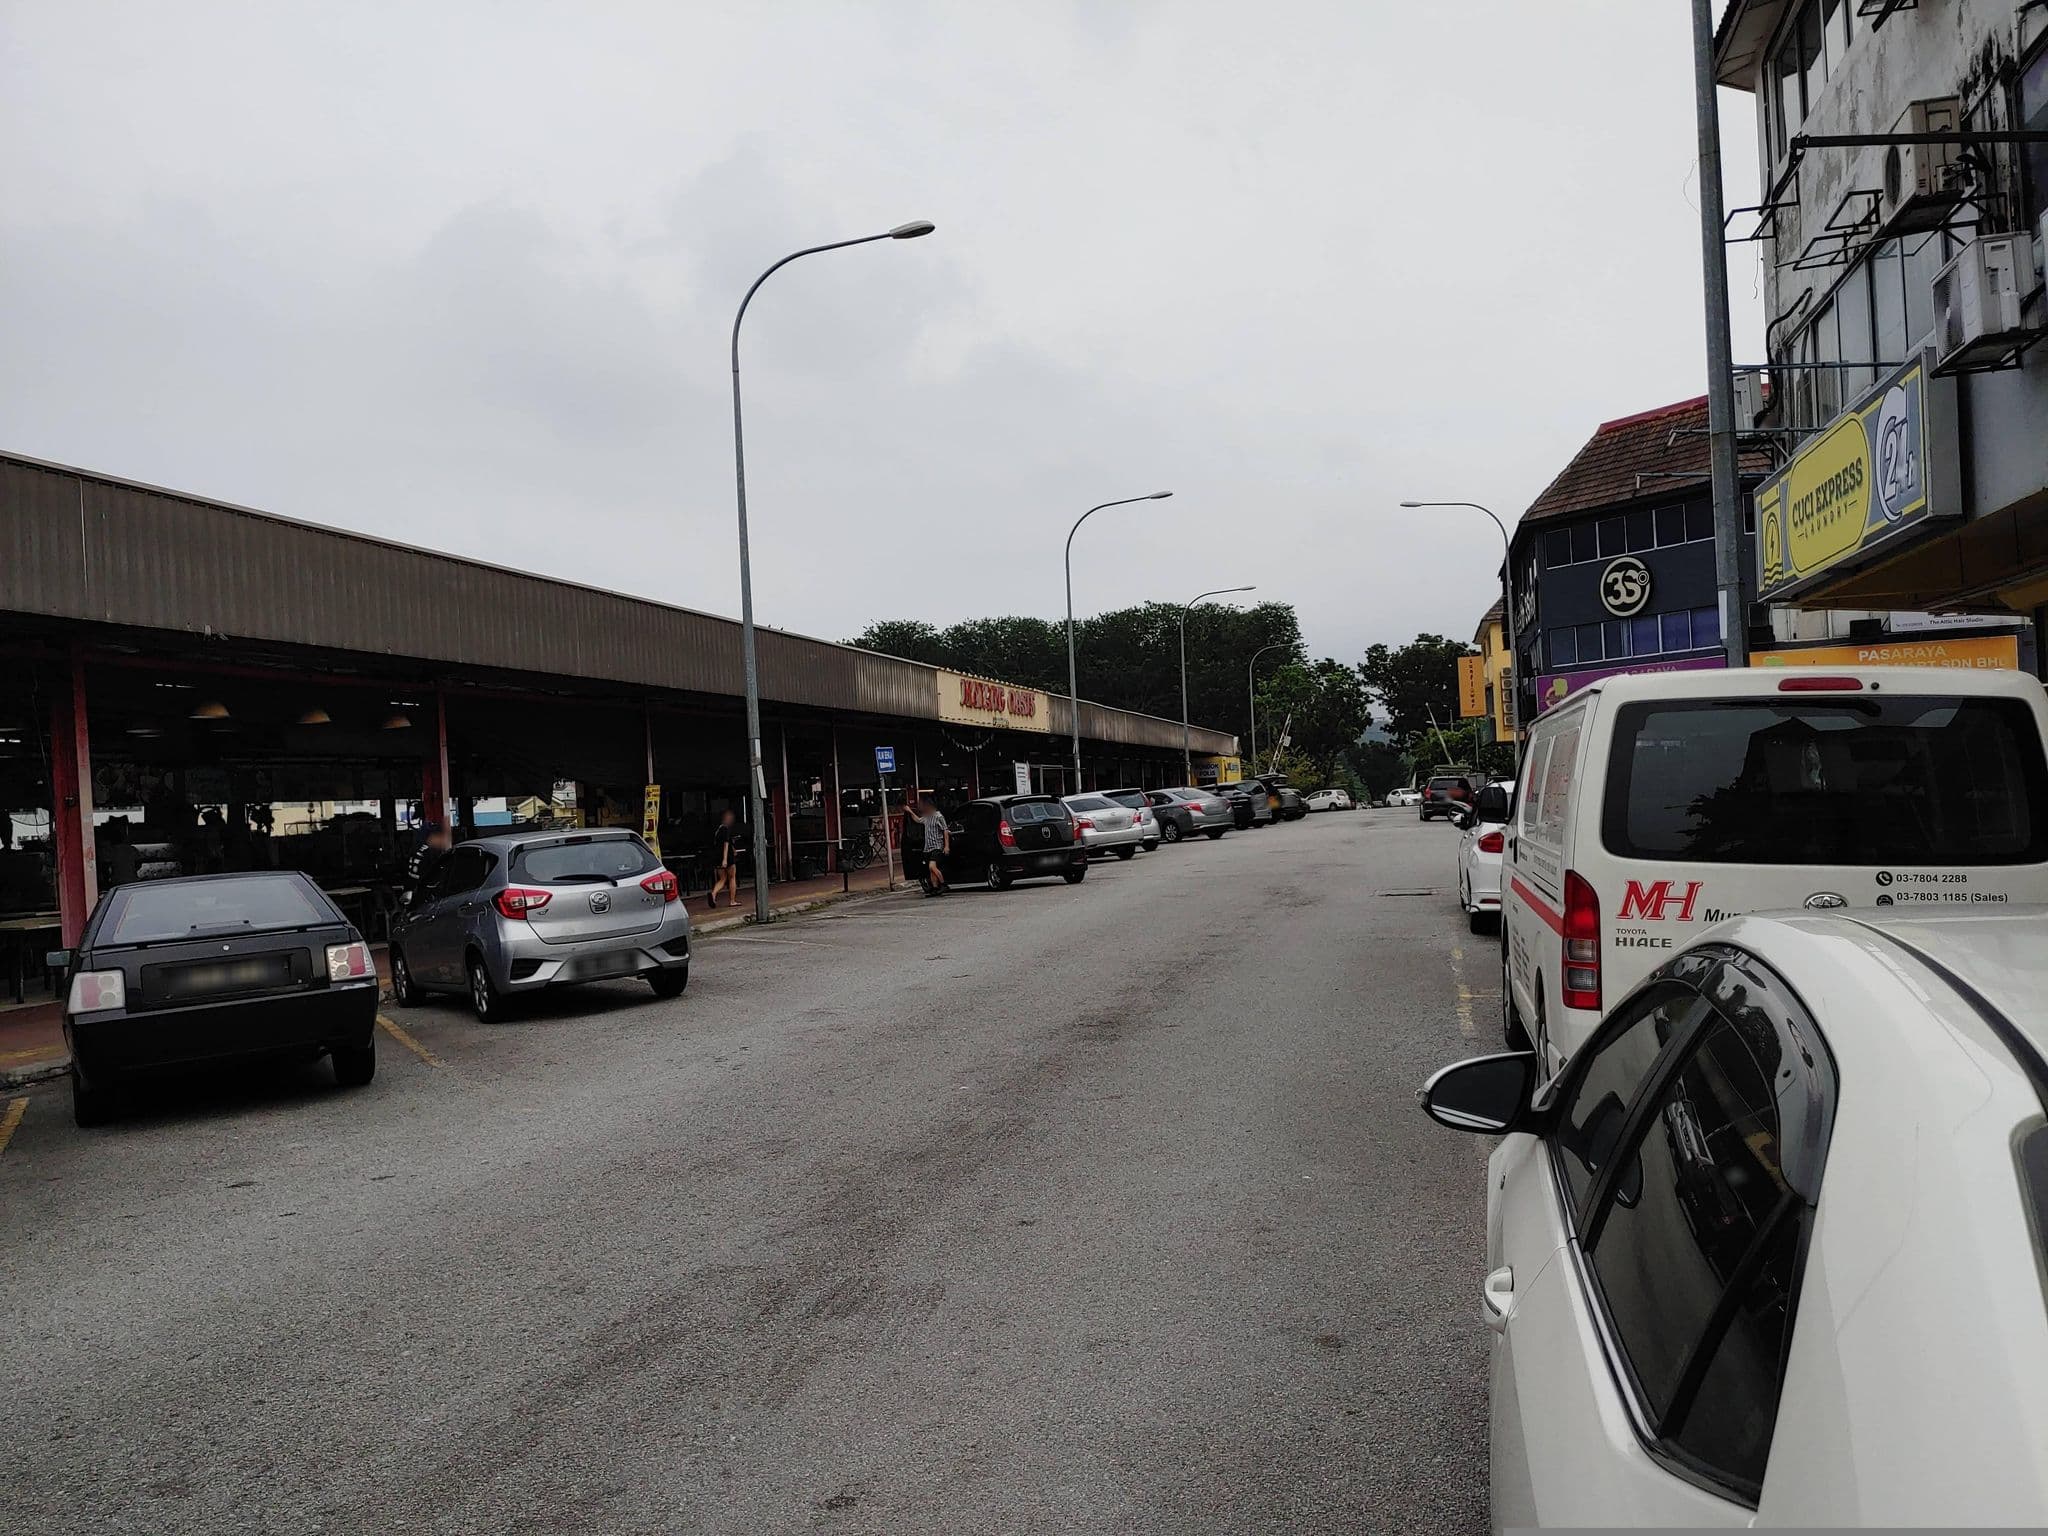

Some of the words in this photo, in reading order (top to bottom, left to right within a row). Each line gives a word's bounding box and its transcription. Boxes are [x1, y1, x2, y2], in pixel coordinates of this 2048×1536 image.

[1793, 491, 1814, 528] CUCI
[1816, 456, 1863, 513] EXPRESS
[1804, 501, 1848, 539] LAUNDRY
[1859, 645, 1946, 662] PASARAYA
[1896, 873, 1938, 883] 03-7804
[1941, 873, 1968, 883] 2288
[1616, 880, 1704, 922] MH
[1896, 892, 1939, 901] 03-7803
[1942, 892, 1968, 902] 1185
[1970, 893, 2008, 904] (Sales)
[1616, 928, 1647, 936] TOYOTA
[1615, 936, 1673, 948] HIACE
